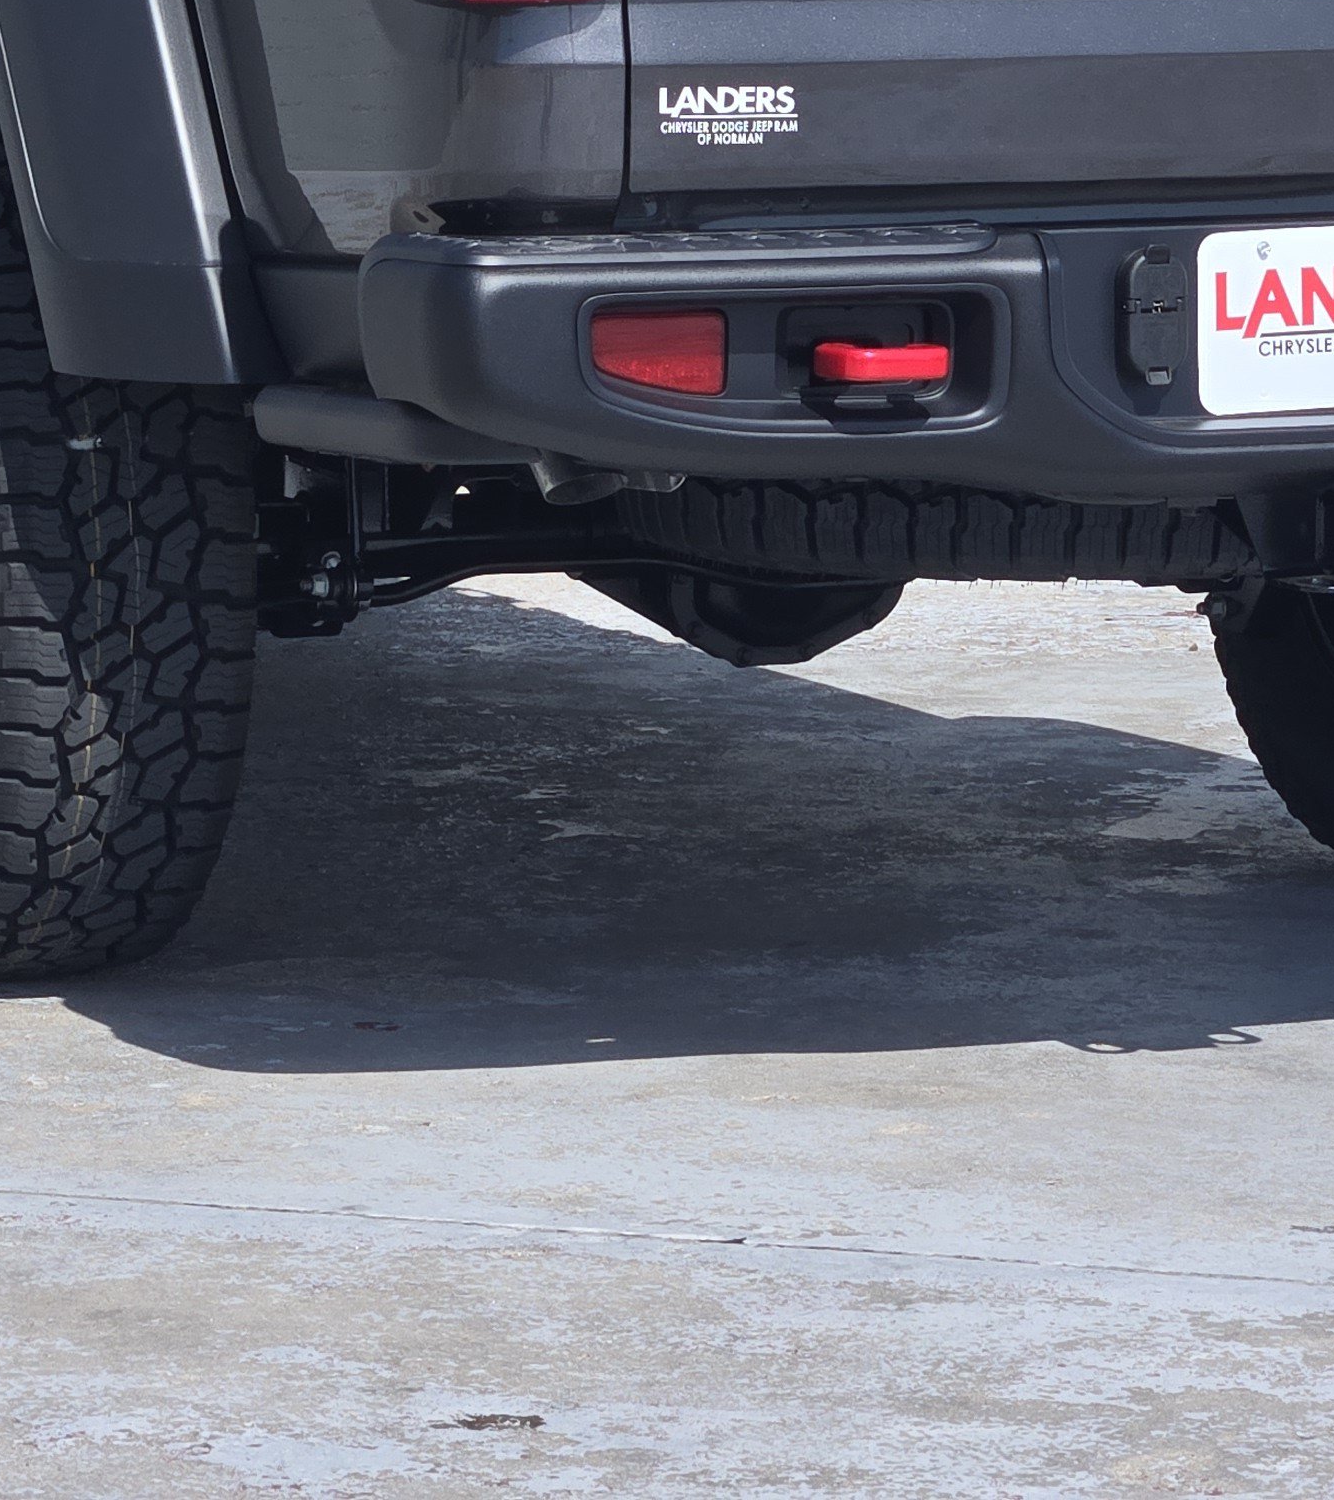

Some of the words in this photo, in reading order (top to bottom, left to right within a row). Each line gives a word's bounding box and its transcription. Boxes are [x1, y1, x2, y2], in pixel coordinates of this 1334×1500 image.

[659, 86, 795, 118] LANDERS
[660, 121, 709, 134] CHRYSLER
[712, 120, 749, 133] DODGE
[751, 120, 773, 132] JEEP
[774, 120, 798, 132] RAM
[697, 133, 712, 146] OF
[714, 132, 763, 145] NORMAN
